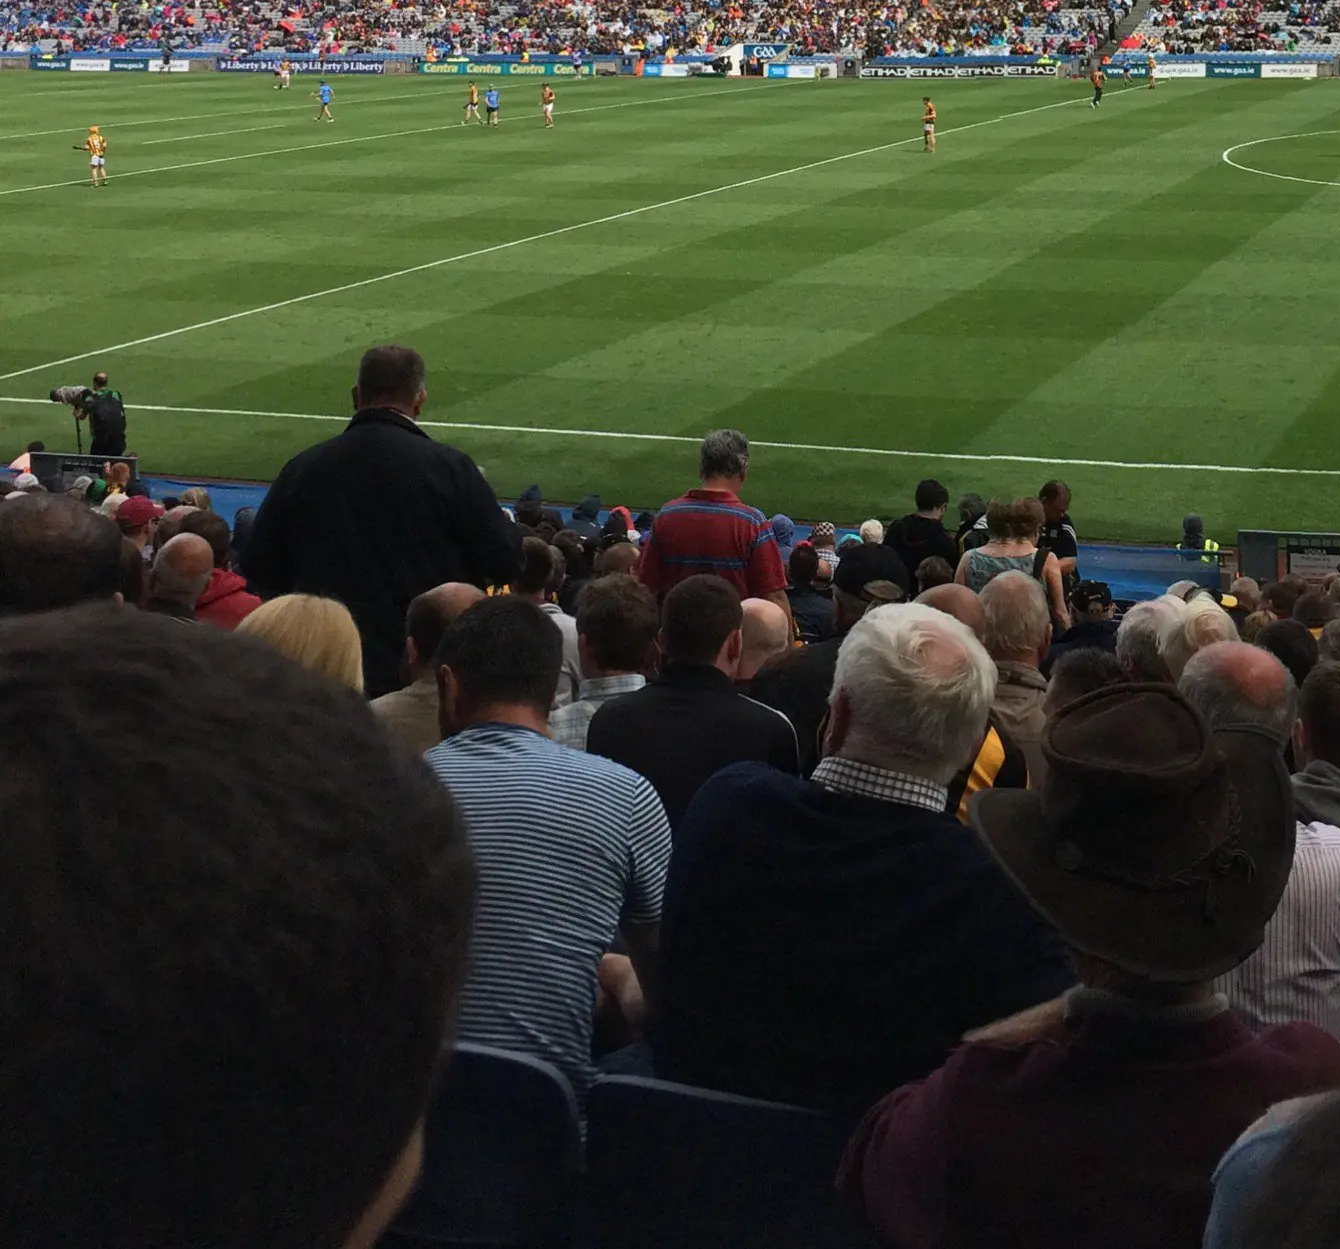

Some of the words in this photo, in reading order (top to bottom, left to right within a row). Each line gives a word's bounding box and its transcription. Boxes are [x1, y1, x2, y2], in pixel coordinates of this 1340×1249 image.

[227, 60, 259, 72] Liberty
[350, 60, 384, 72] Liberty
[423, 63, 459, 74] Centra
[466, 63, 502, 74] Centra
[510, 63, 545, 74] Centra
[910, 66, 956, 76] ETIHAD
[957, 66, 1004, 76] ETIHAD
[1007, 65, 1055, 75] ETIHAD
[861, 67, 907, 77] ETIHAD
